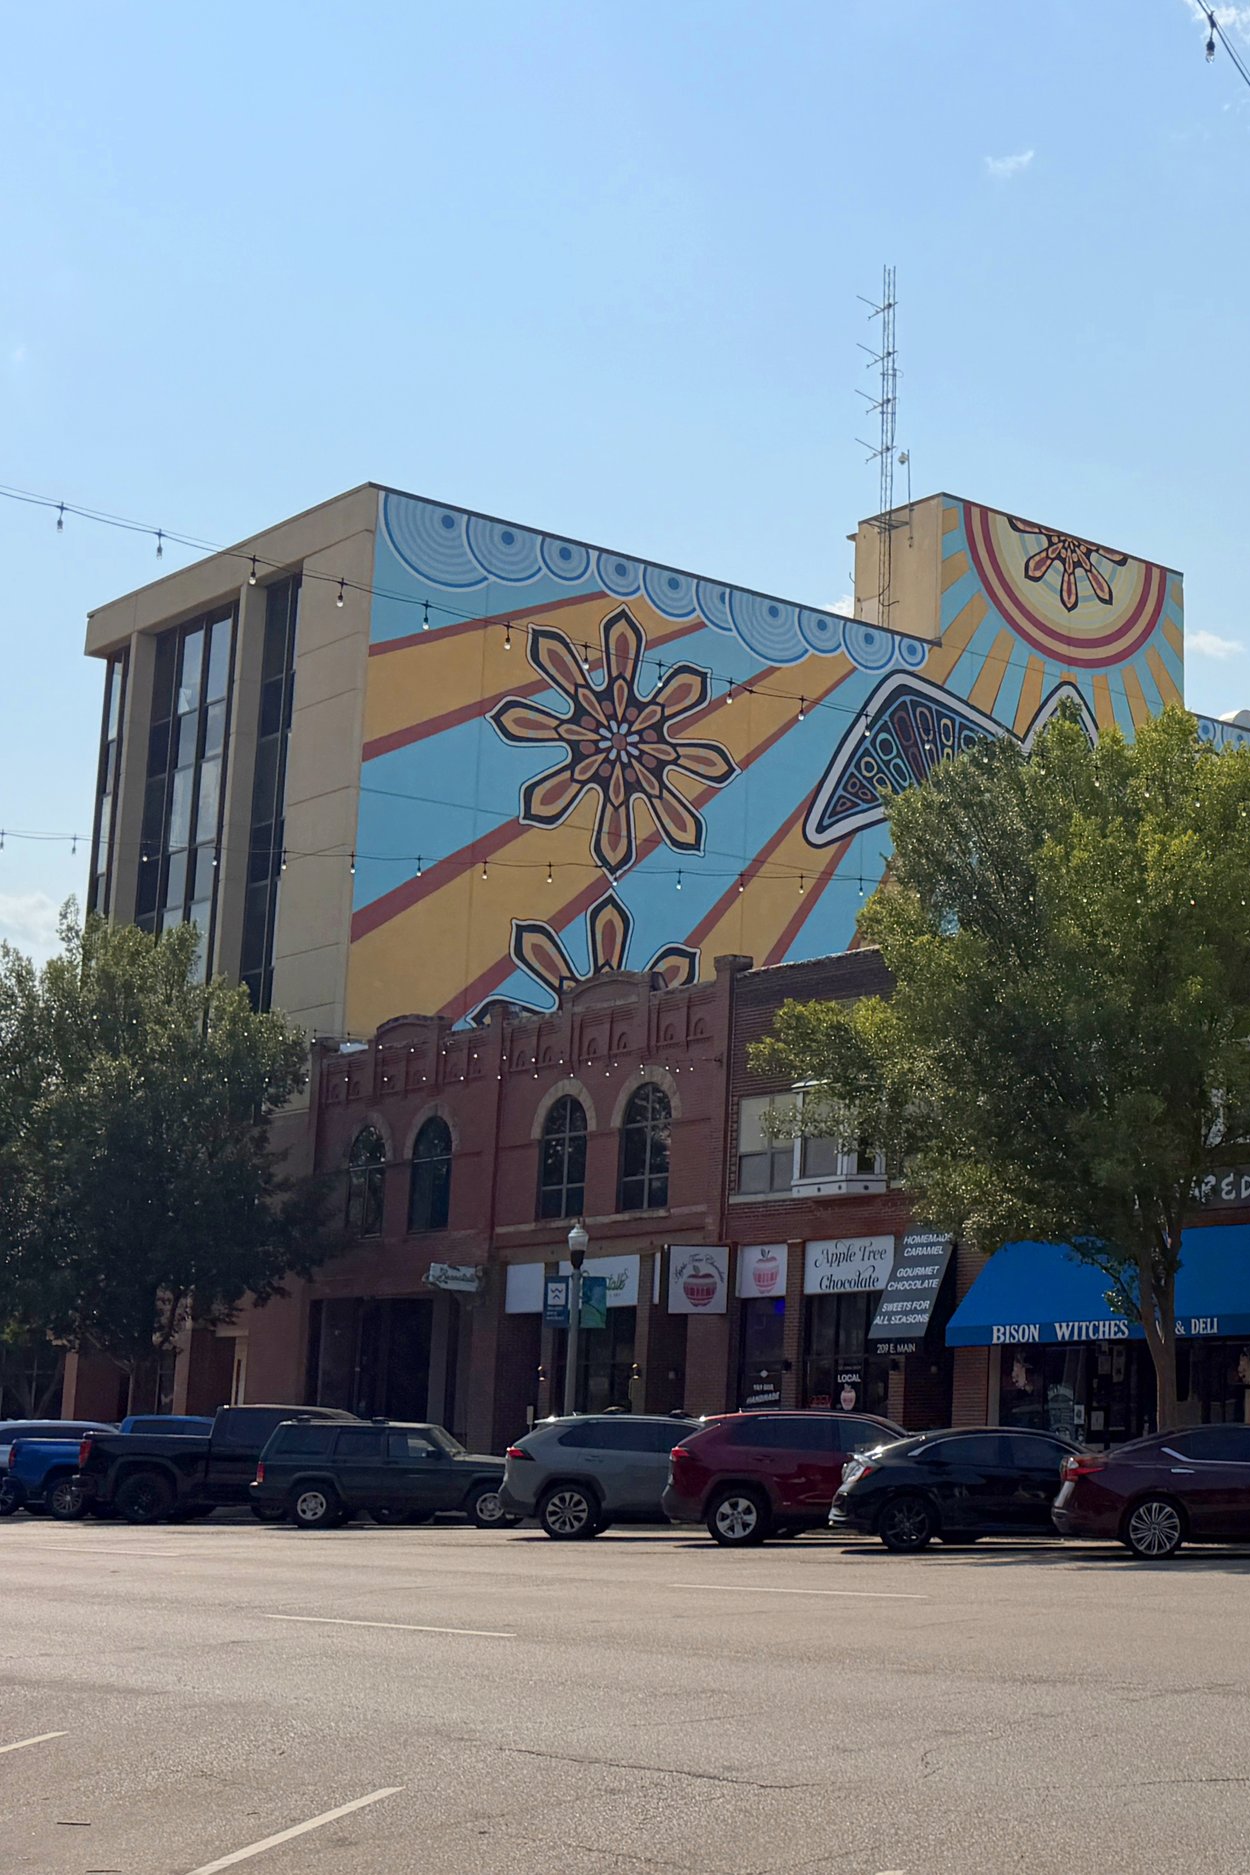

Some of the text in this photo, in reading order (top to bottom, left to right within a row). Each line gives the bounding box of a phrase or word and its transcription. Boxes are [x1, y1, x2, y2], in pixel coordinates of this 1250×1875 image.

[815, 1241, 887, 1268] Apple Tree
[904, 1246, 944, 1257] CARAMEL
[819, 1265, 879, 1291] Chocolate
[896, 1266, 940, 1278] GOURMET
[887, 1279, 940, 1291] CHOCOLATE
[881, 1300, 930, 1312] SWEETS FOR
[873, 1313, 929, 1325] ALL SEASONS
[991, 1317, 1218, 1344] BISON WITCHES & DELI
[876, 1344, 889, 1354] 209
[897, 1343, 916, 1353] MAIN
[837, 1373, 861, 1383] LOCAL
